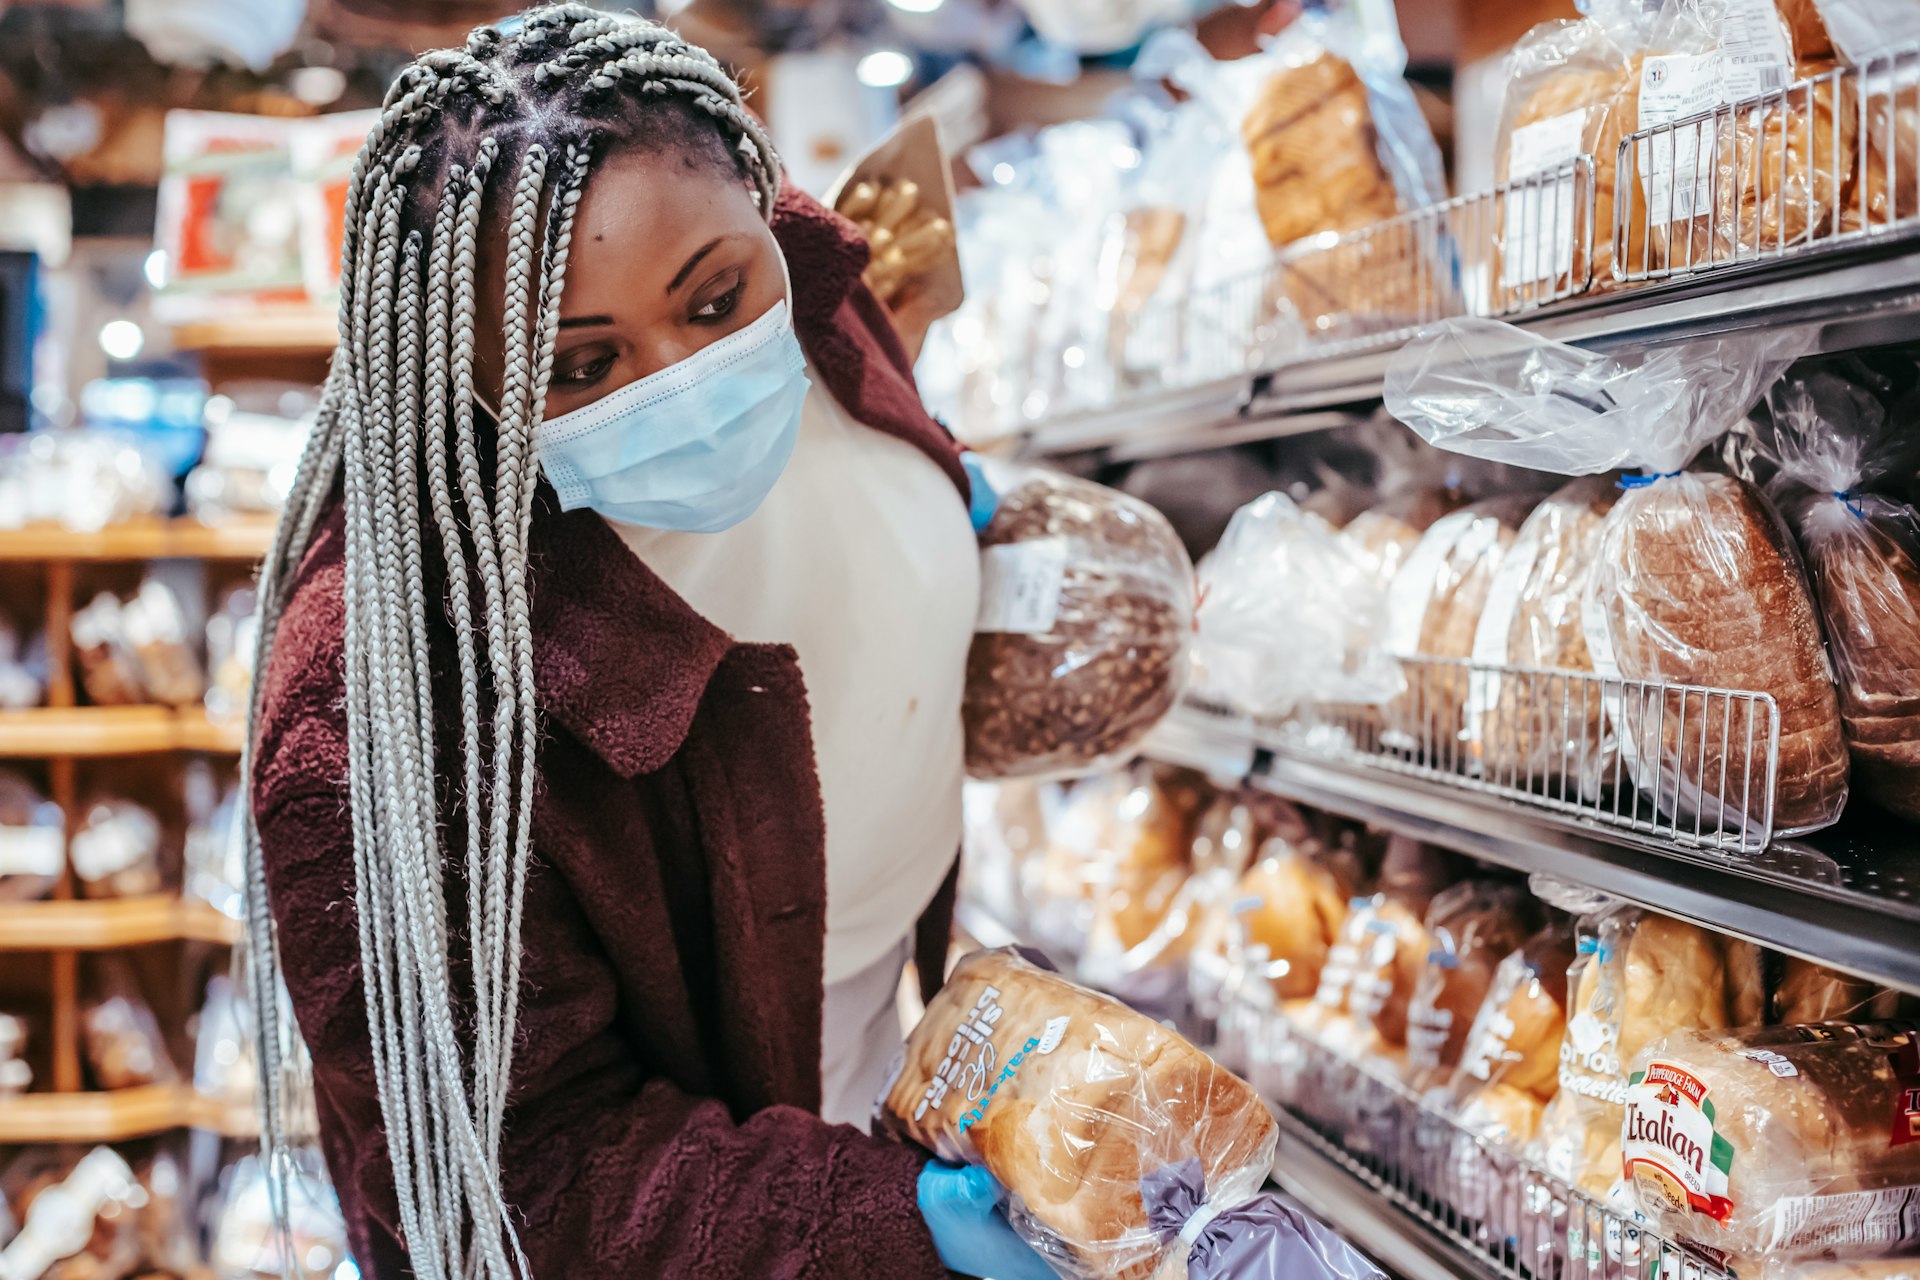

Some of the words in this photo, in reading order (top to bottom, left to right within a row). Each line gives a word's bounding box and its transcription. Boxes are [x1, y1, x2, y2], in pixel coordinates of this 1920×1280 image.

[958, 1041, 997, 1101] the
[958, 1037, 1041, 1134] bakerly
[1648, 1065, 1684, 1086] PEPPERIDGE
[1682, 1075, 1701, 1100] FARM
[1627, 1103, 1704, 1175] Italian
[1663, 1183, 1686, 1211] Seeds
[1684, 1170, 1701, 1192] BREAD
